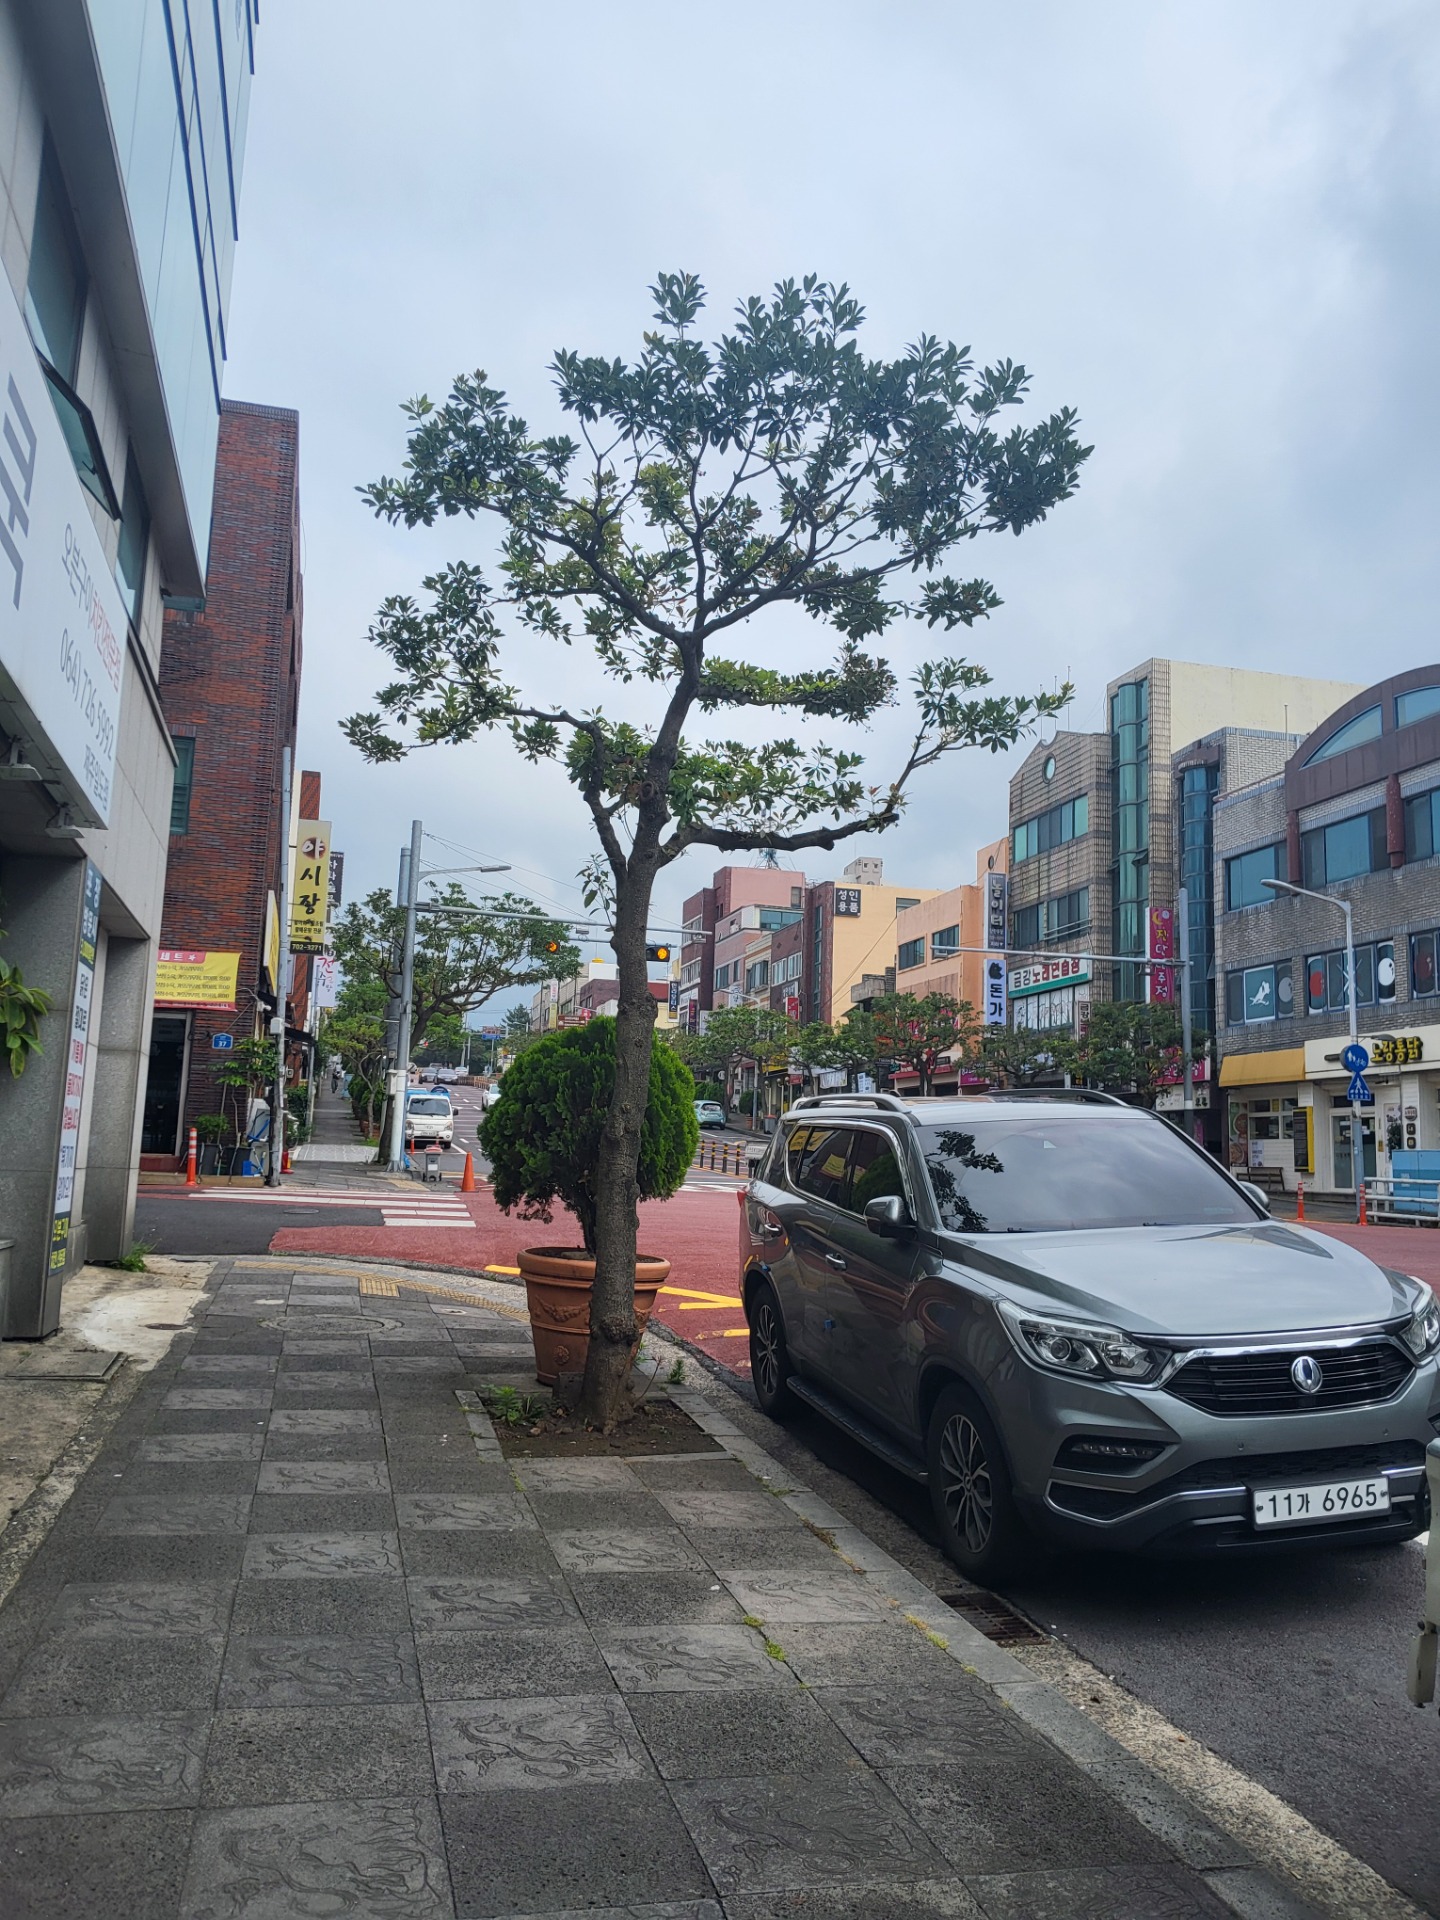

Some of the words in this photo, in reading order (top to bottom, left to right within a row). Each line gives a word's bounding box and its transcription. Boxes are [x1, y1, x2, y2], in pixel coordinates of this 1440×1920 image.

[60, 628, 81, 704] 064)
[80, 668, 97, 728] 726
[95, 696, 114, 762] 5992
[299, 838, 326, 915] 야시장
[838, 890, 858, 901] 성인
[838, 902, 859, 913] 용품
[991, 879, 1004, 927] 놀이터
[291, 943, 322, 952] 702-3271
[1370, 1036, 1421, 1063] 노랑통닭
[1268, 1493, 1311, 1519] 11가
[1322, 1483, 1378, 1513] 6965
